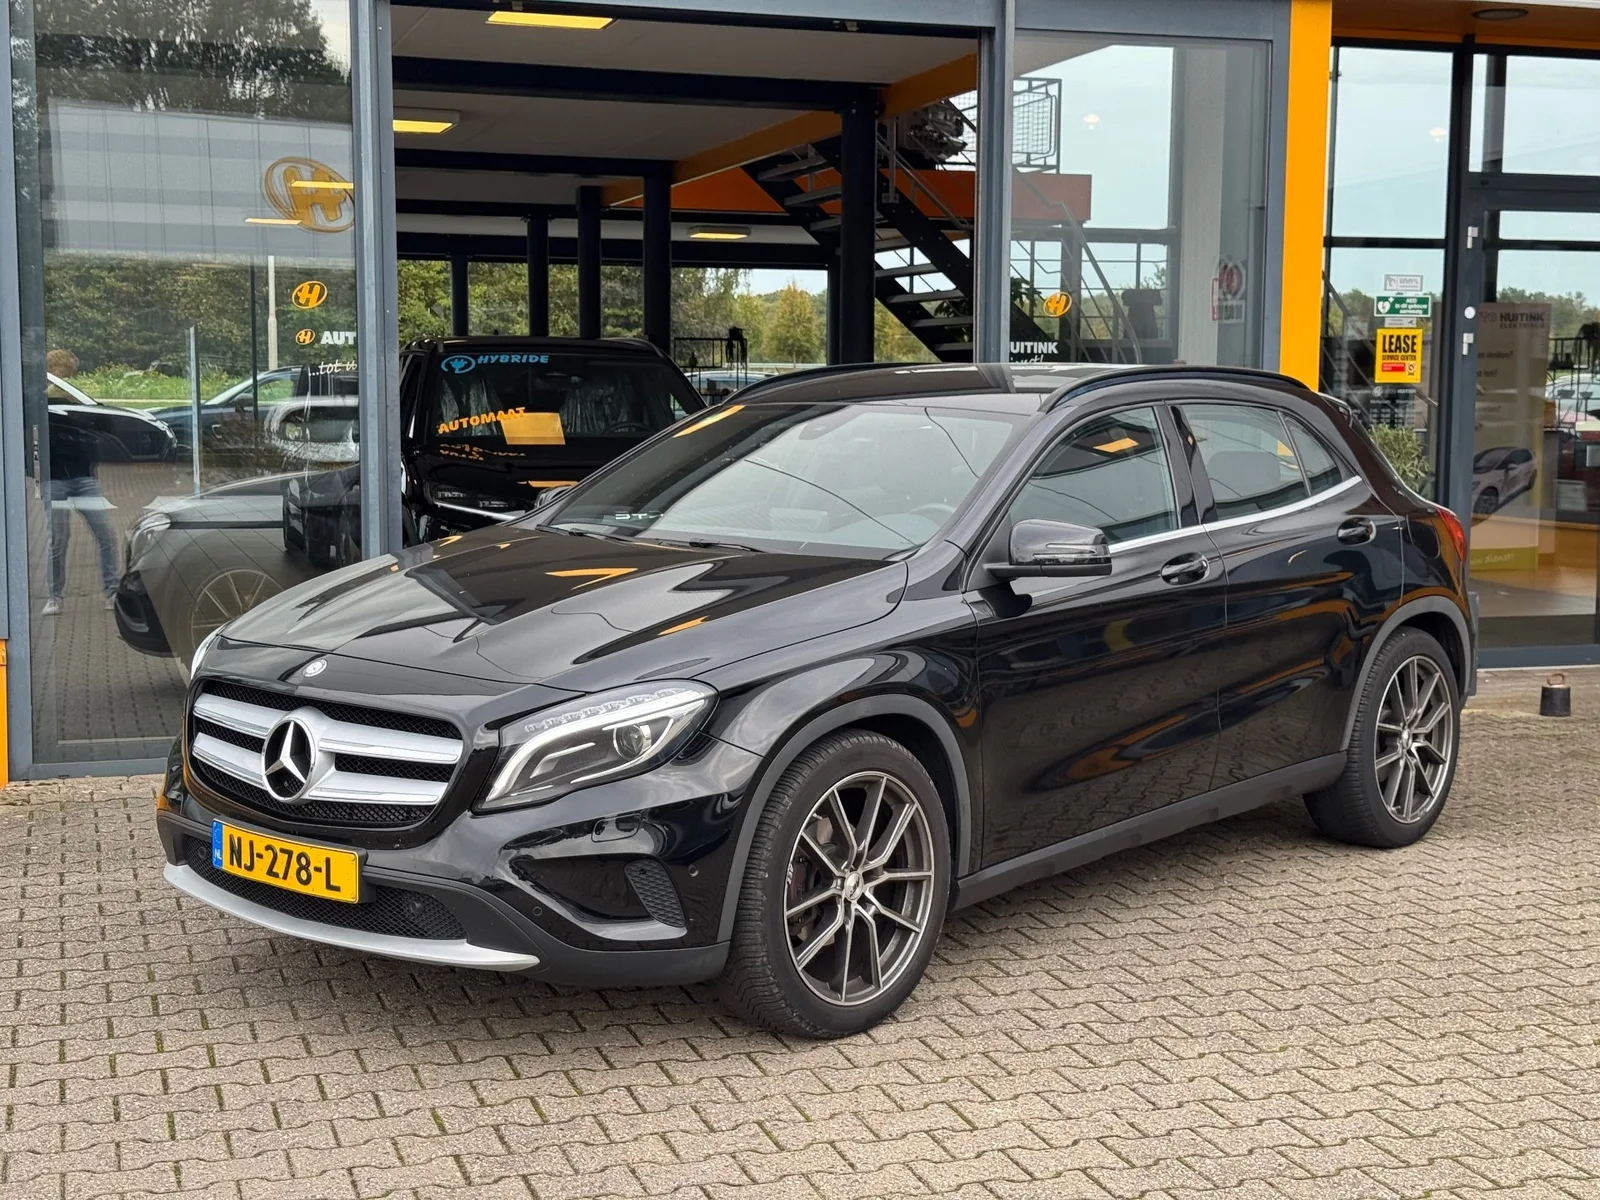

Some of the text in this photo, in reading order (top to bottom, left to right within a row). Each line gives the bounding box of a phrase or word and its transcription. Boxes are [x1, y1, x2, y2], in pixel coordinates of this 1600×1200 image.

[1500, 312, 1545, 321] HUITINK
[1382, 334, 1417, 353] LEASE
[477, 354, 549, 364] HYBRIDE
[438, 406, 526, 434] AUTOMAAT
[214, 848, 222, 860] NL
[229, 833, 342, 893] NJ-278-L
